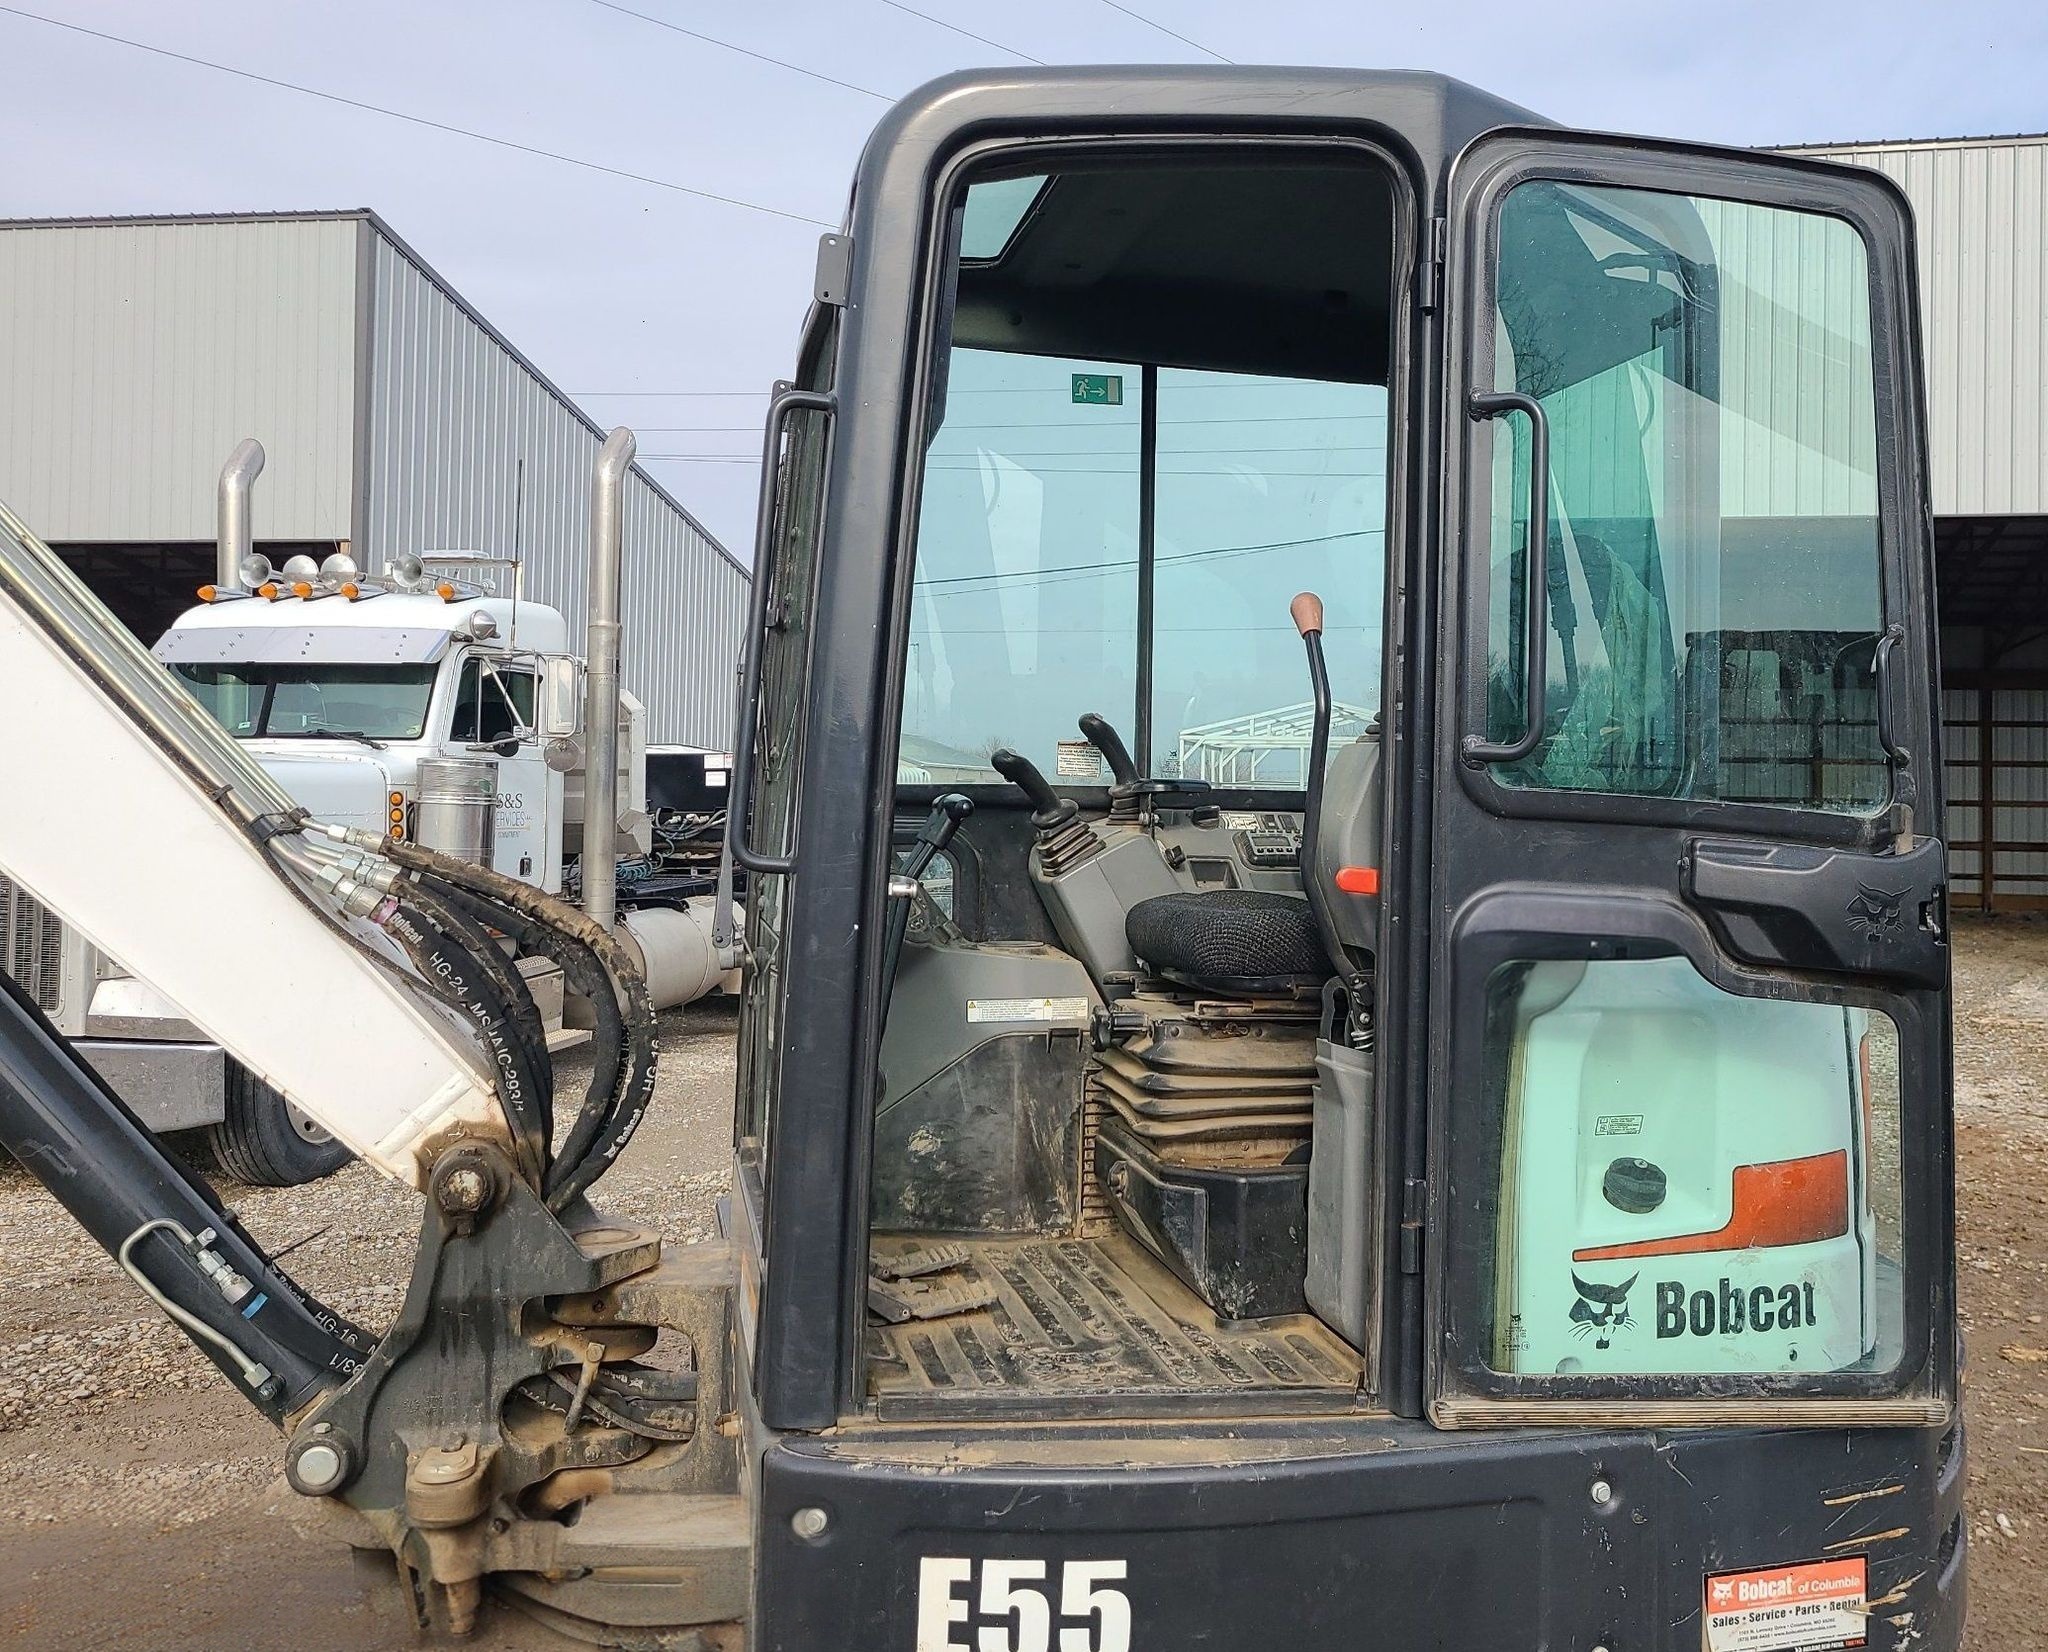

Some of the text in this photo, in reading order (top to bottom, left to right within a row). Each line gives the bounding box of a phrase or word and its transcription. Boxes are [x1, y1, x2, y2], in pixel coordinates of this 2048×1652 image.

[496, 793, 523, 809] S&S
[430, 952, 469, 996] HG-24
[1655, 1278, 1817, 1339] Bobcat
[314, 1311, 359, 1346] HG-16
[917, 1556, 1131, 1652] E55
[1738, 1576, 1794, 1601] Bobcat
[1797, 1583, 1810, 1594] of
[1811, 1575, 1861, 1592] Columbia
[1712, 1615, 1740, 1628] Sales
[1749, 1608, 1786, 1623] Service
[1795, 1603, 1821, 1616] Parts
[1829, 1597, 1861, 1612] Rental
